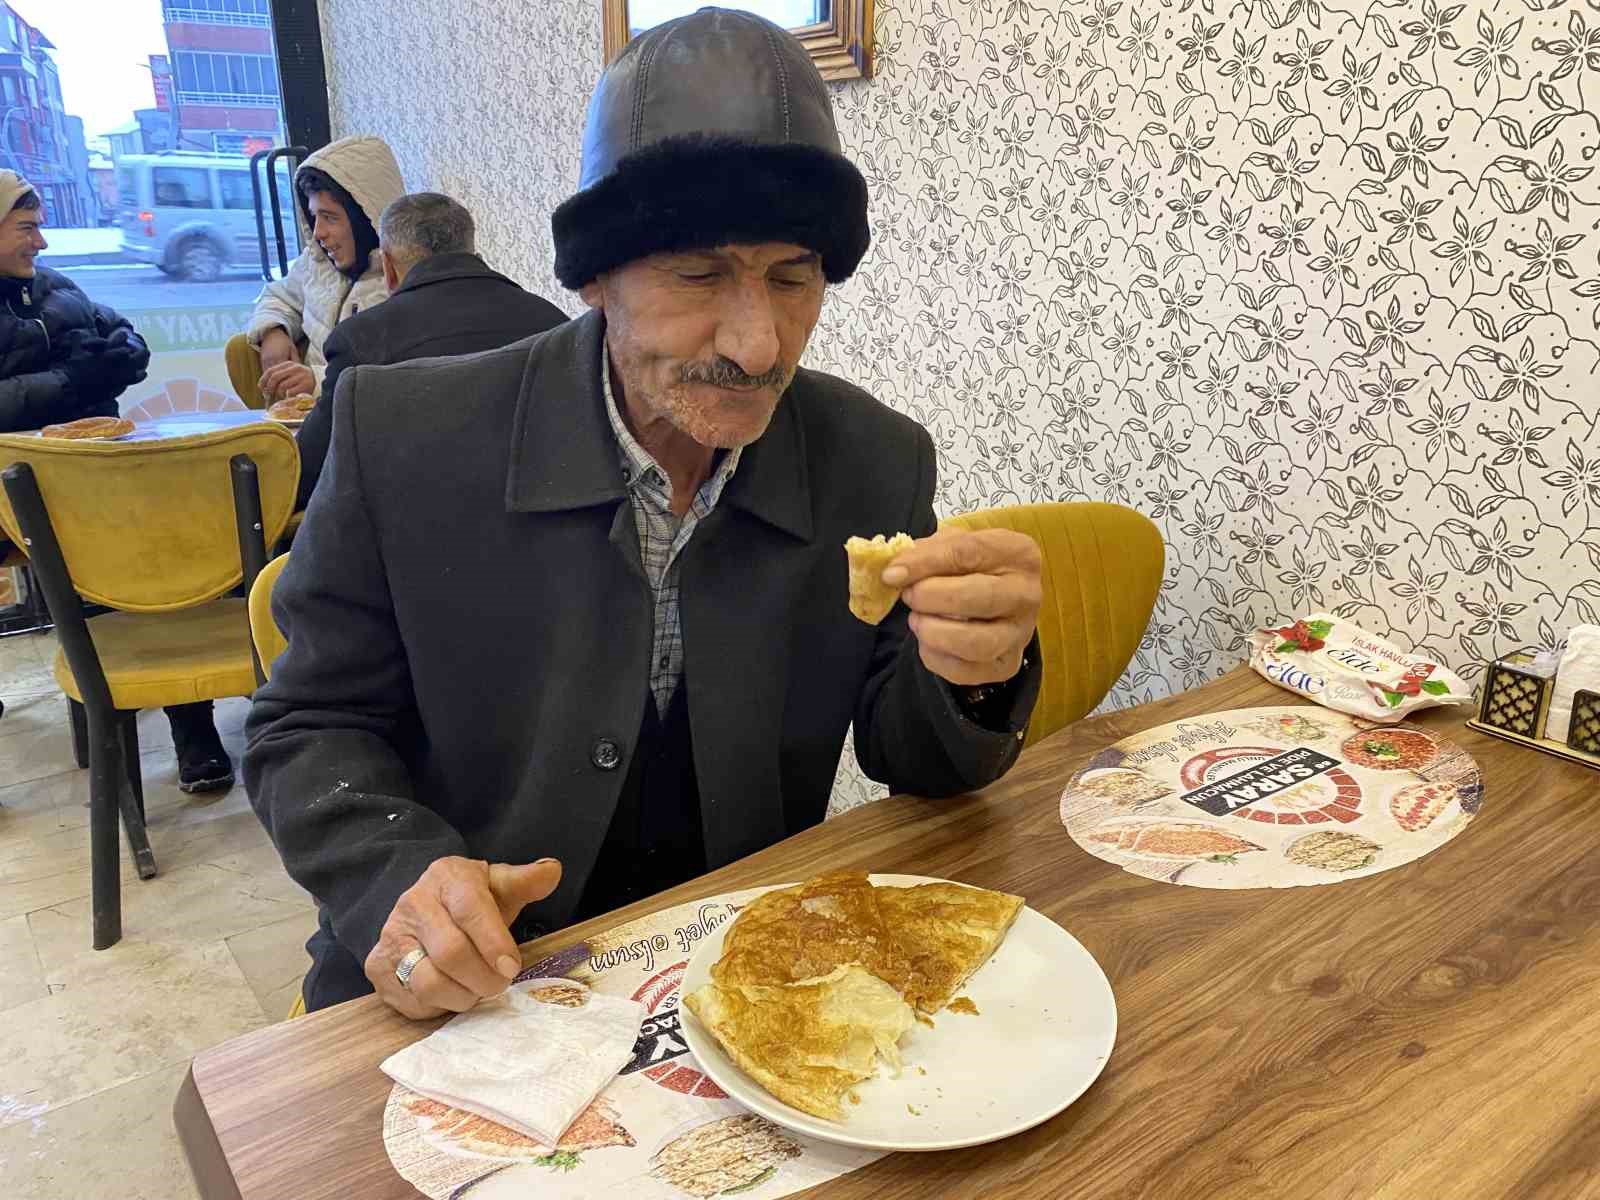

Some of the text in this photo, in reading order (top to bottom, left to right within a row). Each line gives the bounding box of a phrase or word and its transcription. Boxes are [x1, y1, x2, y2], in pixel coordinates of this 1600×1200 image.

[1187, 770, 1260, 803] LAHMACUN
[1219, 763, 1314, 809] SARAY
[1257, 763, 1283, 774] VE
[589, 904, 740, 973] yet olsun
